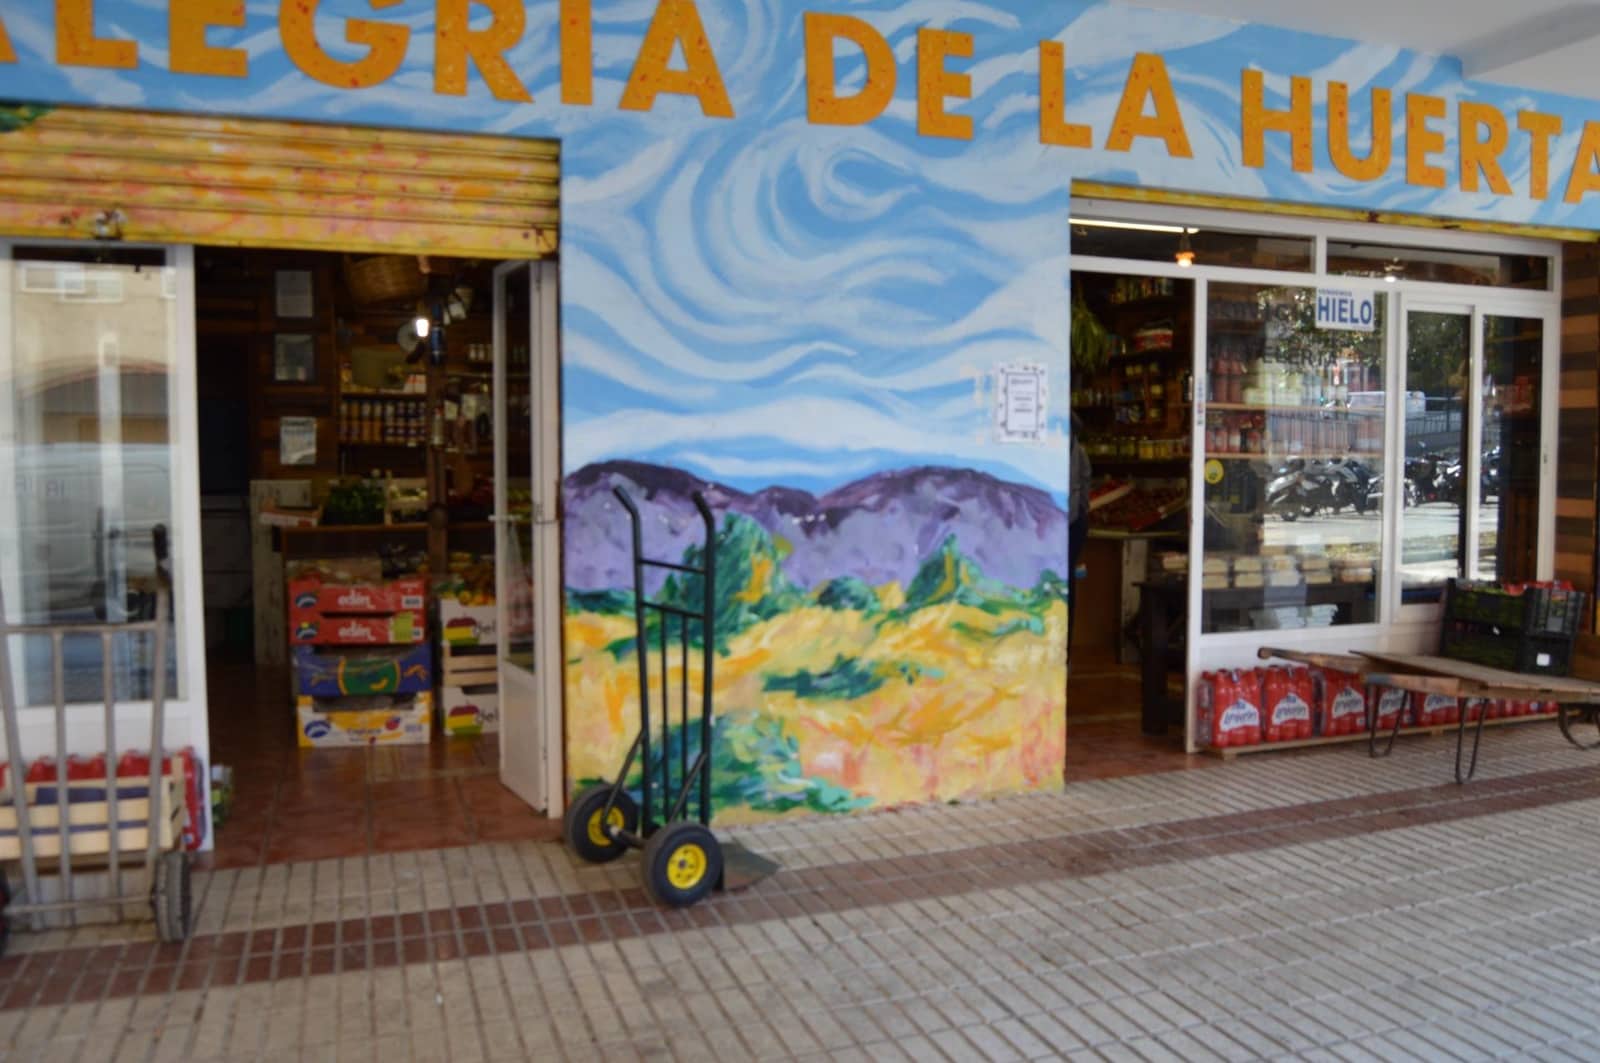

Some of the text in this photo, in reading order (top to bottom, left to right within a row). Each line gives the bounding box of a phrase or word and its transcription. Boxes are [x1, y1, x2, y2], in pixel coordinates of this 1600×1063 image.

[0, 0, 736, 118] LEGRIA
[803, 12, 974, 140] DE
[1038, 40, 1193, 158] LA
[1317, 297, 1373, 325] HIELO
